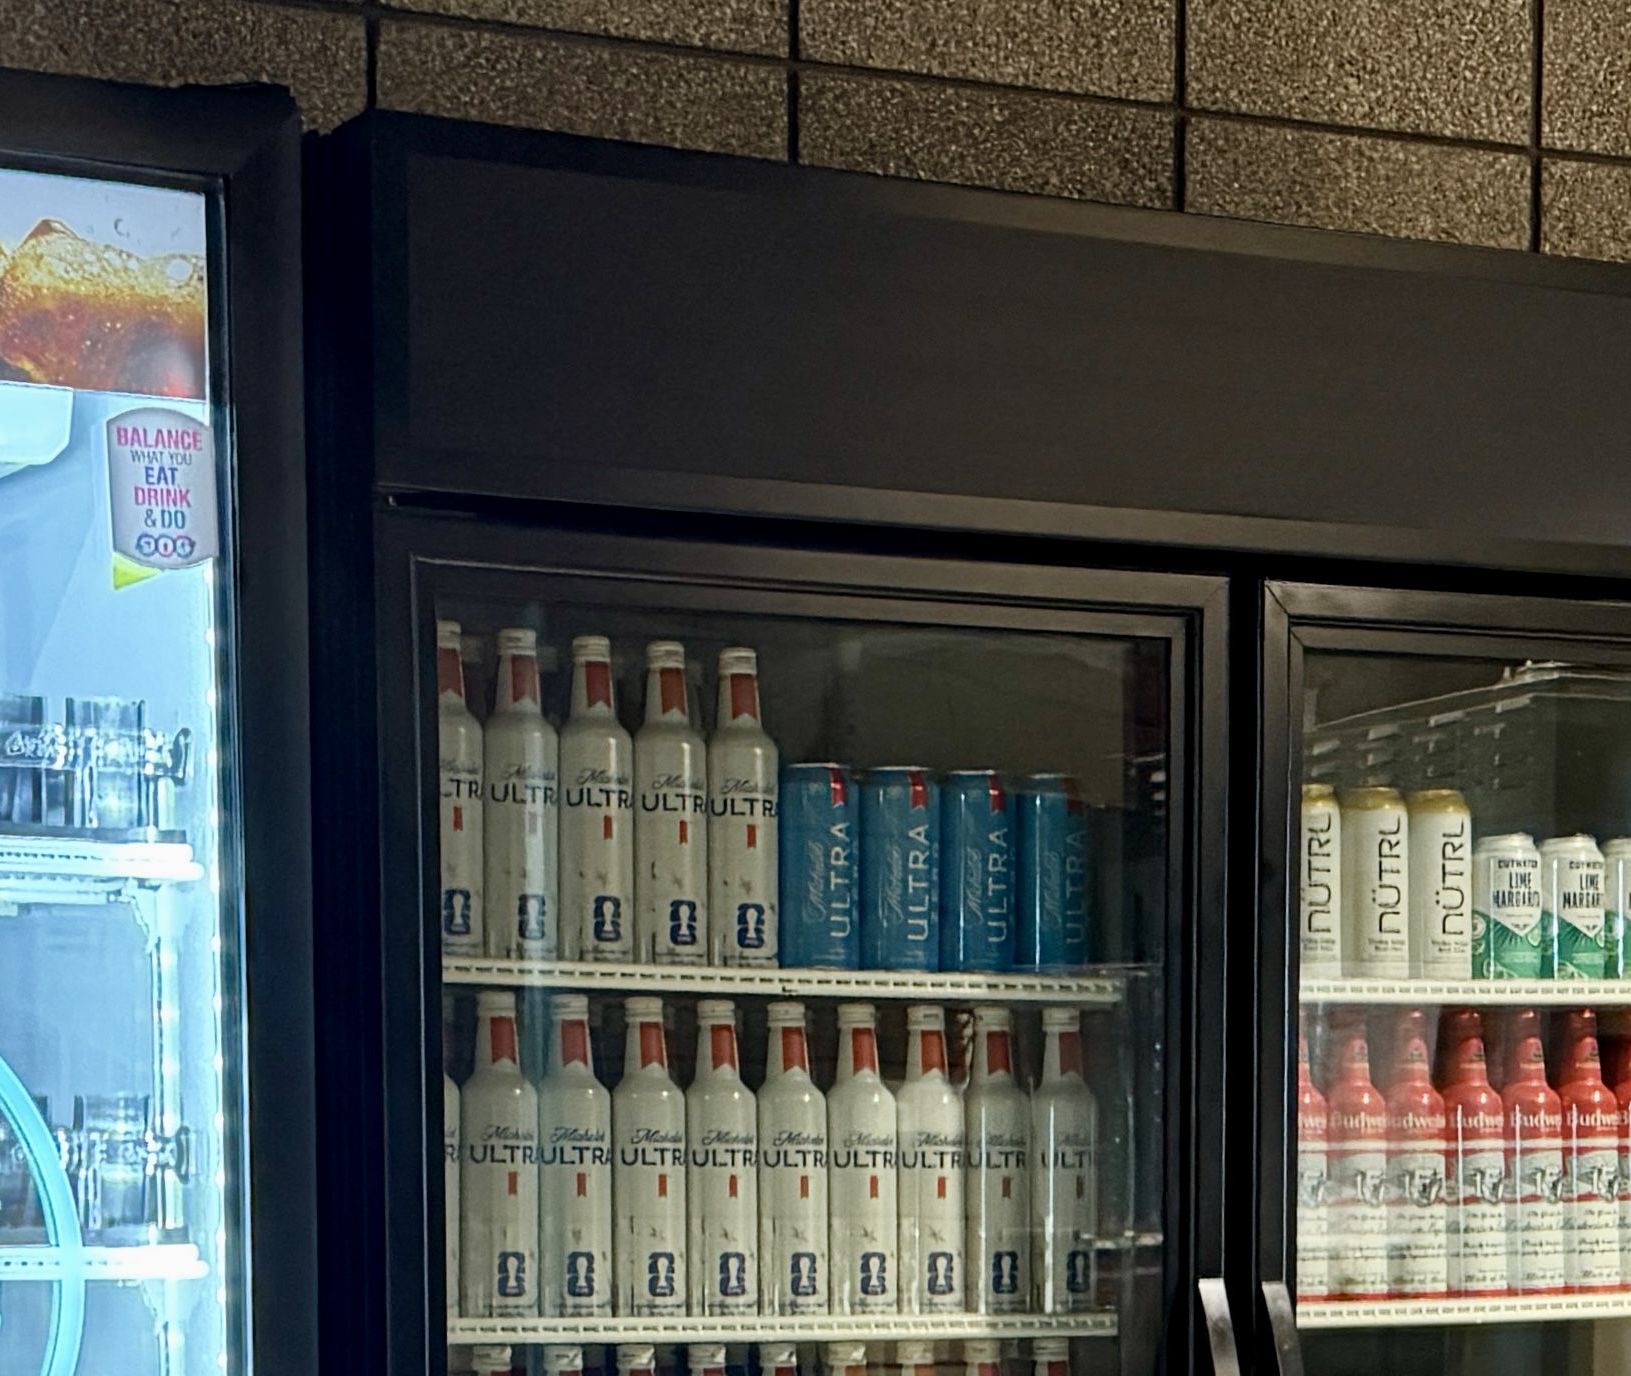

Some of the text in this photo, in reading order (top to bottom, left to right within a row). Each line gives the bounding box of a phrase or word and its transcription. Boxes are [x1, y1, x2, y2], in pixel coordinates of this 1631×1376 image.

[116, 426, 203, 452] BALANCE
[129, 449, 193, 467] WHAT YOU
[133, 485, 192, 509] DRINK
[144, 507, 187, 530] & DO
[566, 787, 632, 810] ULTR
[642, 792, 707, 815] ULTR
[829, 821, 851, 937] ULTRA
[907, 824, 930, 941] ULTRA
[987, 828, 1009, 943] ULTRA
[621, 1147, 686, 1167] ULTR
